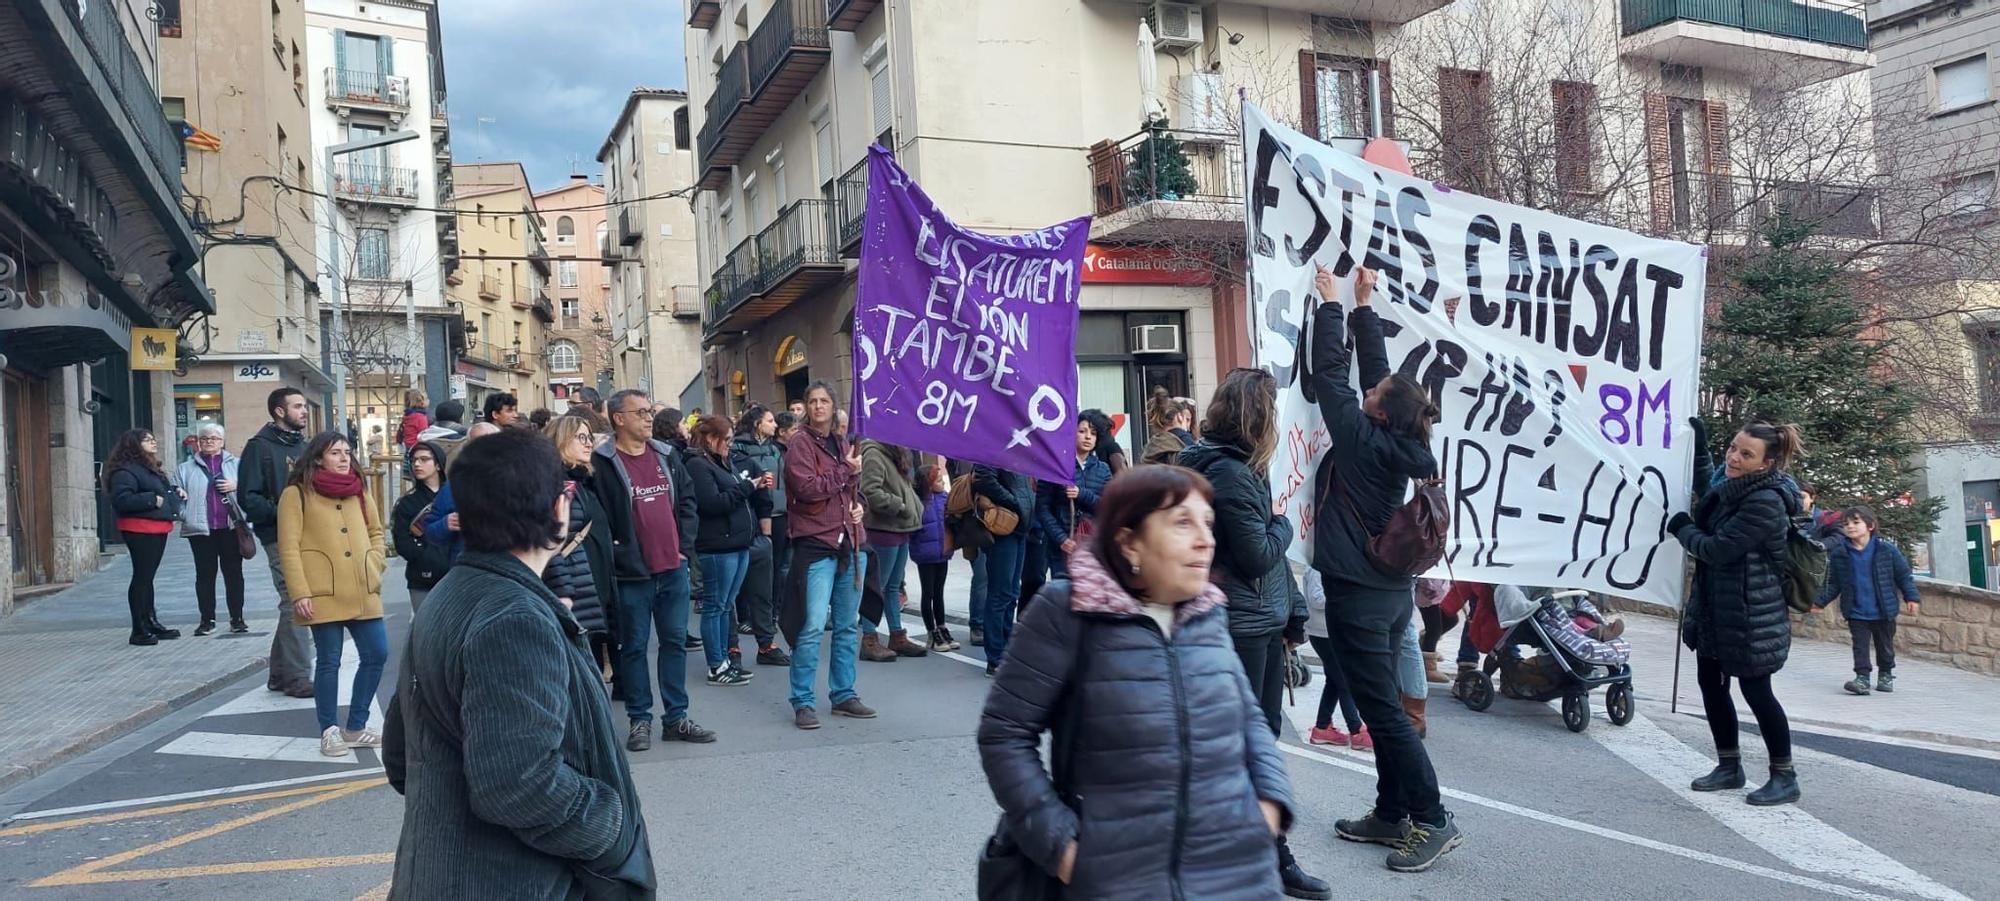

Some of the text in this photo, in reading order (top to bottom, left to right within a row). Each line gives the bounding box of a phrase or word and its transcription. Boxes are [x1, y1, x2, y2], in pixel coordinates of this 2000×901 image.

[967, 251, 1074, 304] ATUREM
[1097, 256, 1152, 270] Catalana
[925, 276, 971, 329] EL
[1464, 213, 1684, 373] CANSAT
[916, 380, 979, 433] 8M
[1598, 379, 1672, 449] 8M
